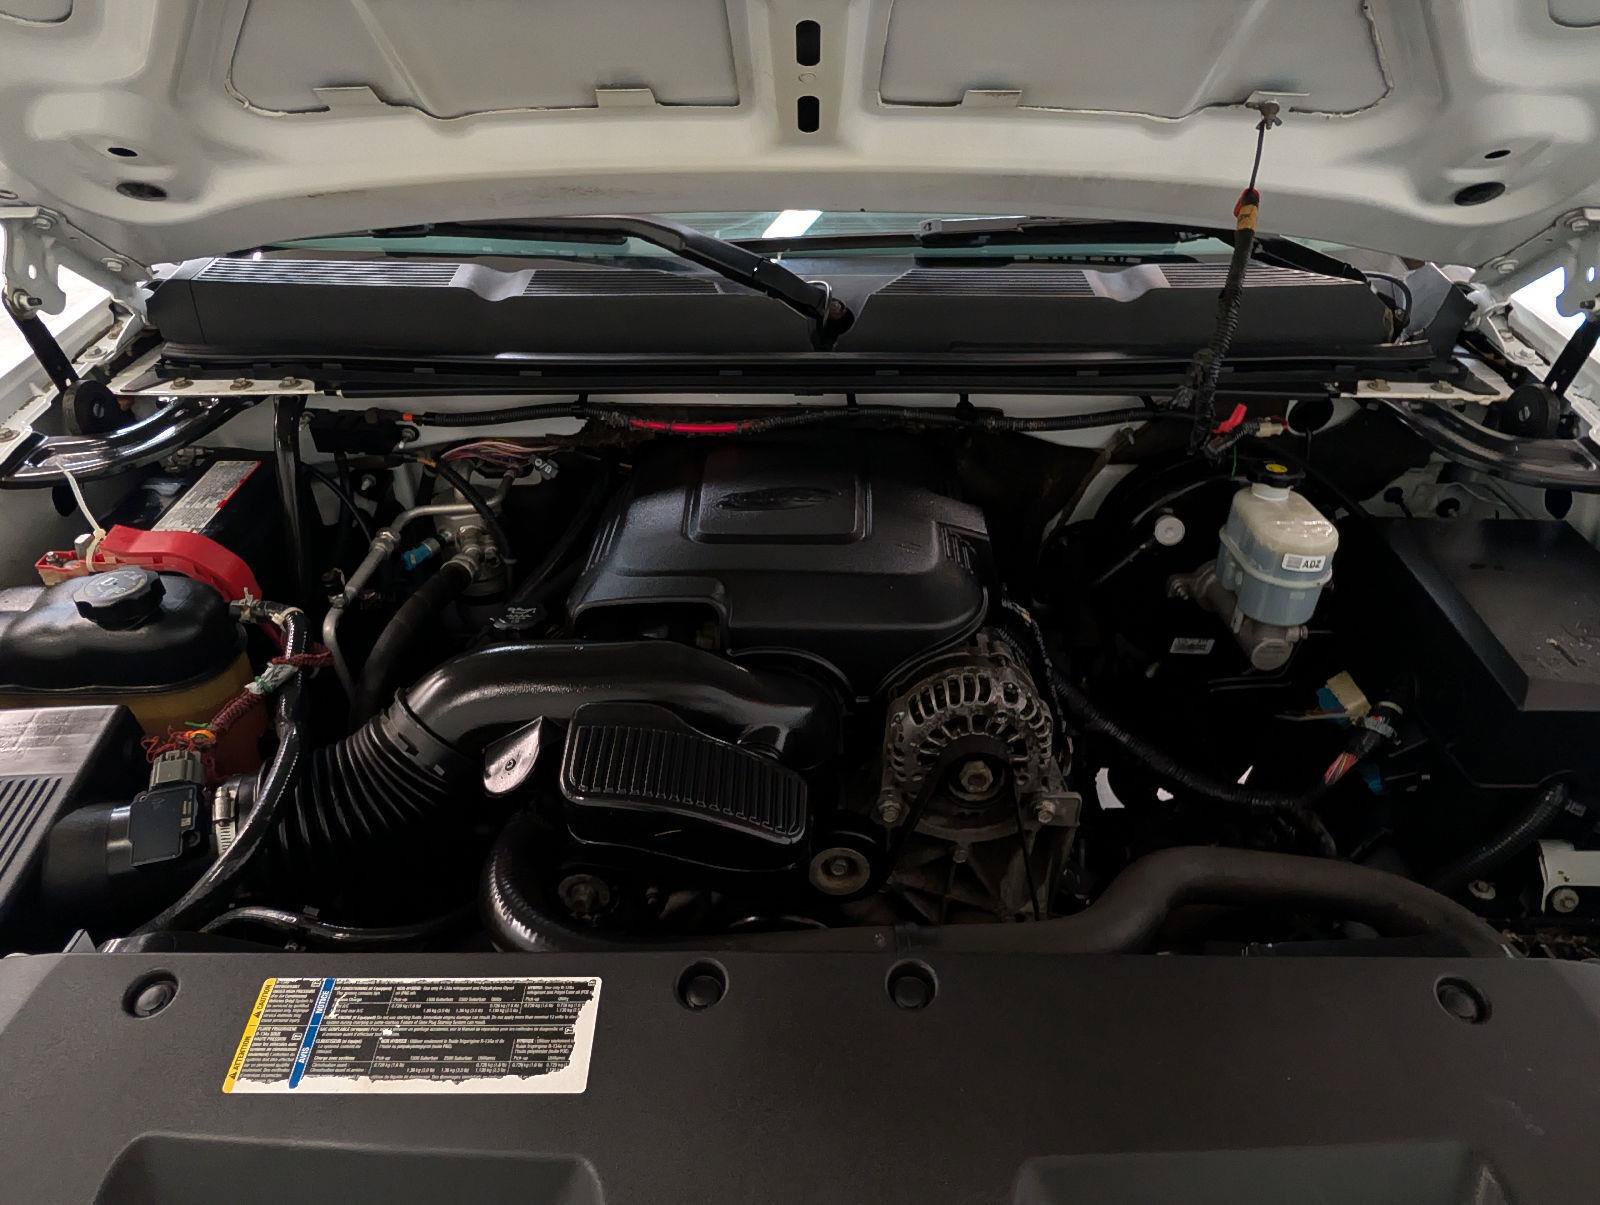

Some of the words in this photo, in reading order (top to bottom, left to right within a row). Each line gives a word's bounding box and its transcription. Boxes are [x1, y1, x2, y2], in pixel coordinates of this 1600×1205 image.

[257, 985, 271, 1009] CAUTION
[315, 991, 329, 1013] NOTICE
[234, 1036, 251, 1070] ATTENTION
[298, 1047, 310, 1063] AVIS
